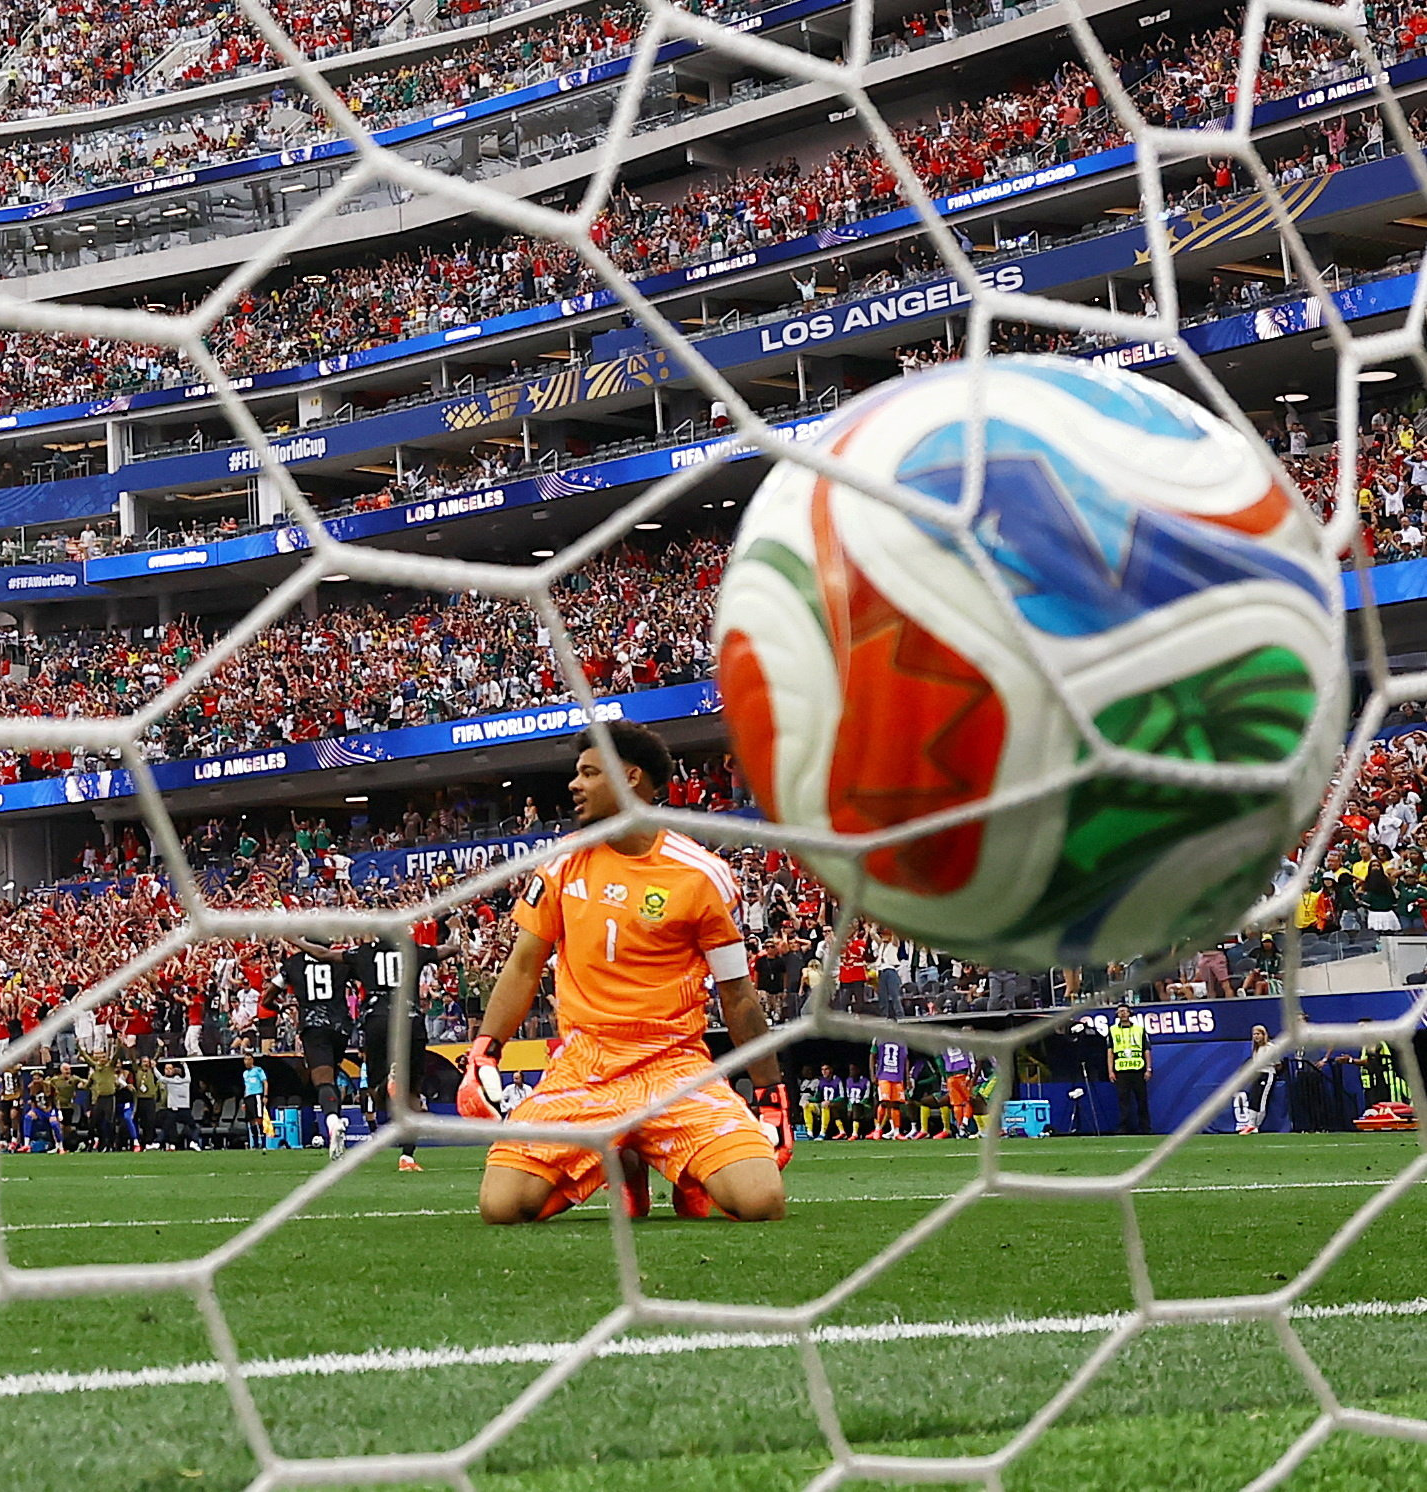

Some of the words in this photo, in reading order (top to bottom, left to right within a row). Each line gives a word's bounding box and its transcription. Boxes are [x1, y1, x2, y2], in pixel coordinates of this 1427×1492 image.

[1298, 91, 1325, 109] LOS
[133, 182, 153, 194] LOS
[947, 194, 972, 210] FIFA
[972, 183, 1013, 203] WORLD
[1013, 176, 1035, 191] CUP
[1035, 164, 1077, 186] 2026
[685, 265, 709, 281] LOS
[708, 253, 757, 274] ANGELES
[761, 320, 835, 352] LOS
[406, 504, 435, 523] LOS
[438, 489, 505, 517] ANGELES
[452, 723, 485, 744] FIFA
[483, 716, 537, 739] WORLD
[537, 710, 568, 731] CUP
[194, 760, 222, 780] LOS
[223, 752, 287, 775] ANGELES
[605, 918, 618, 962] 1
[304, 964, 333, 1001] 19
[373, 951, 404, 987] 10
